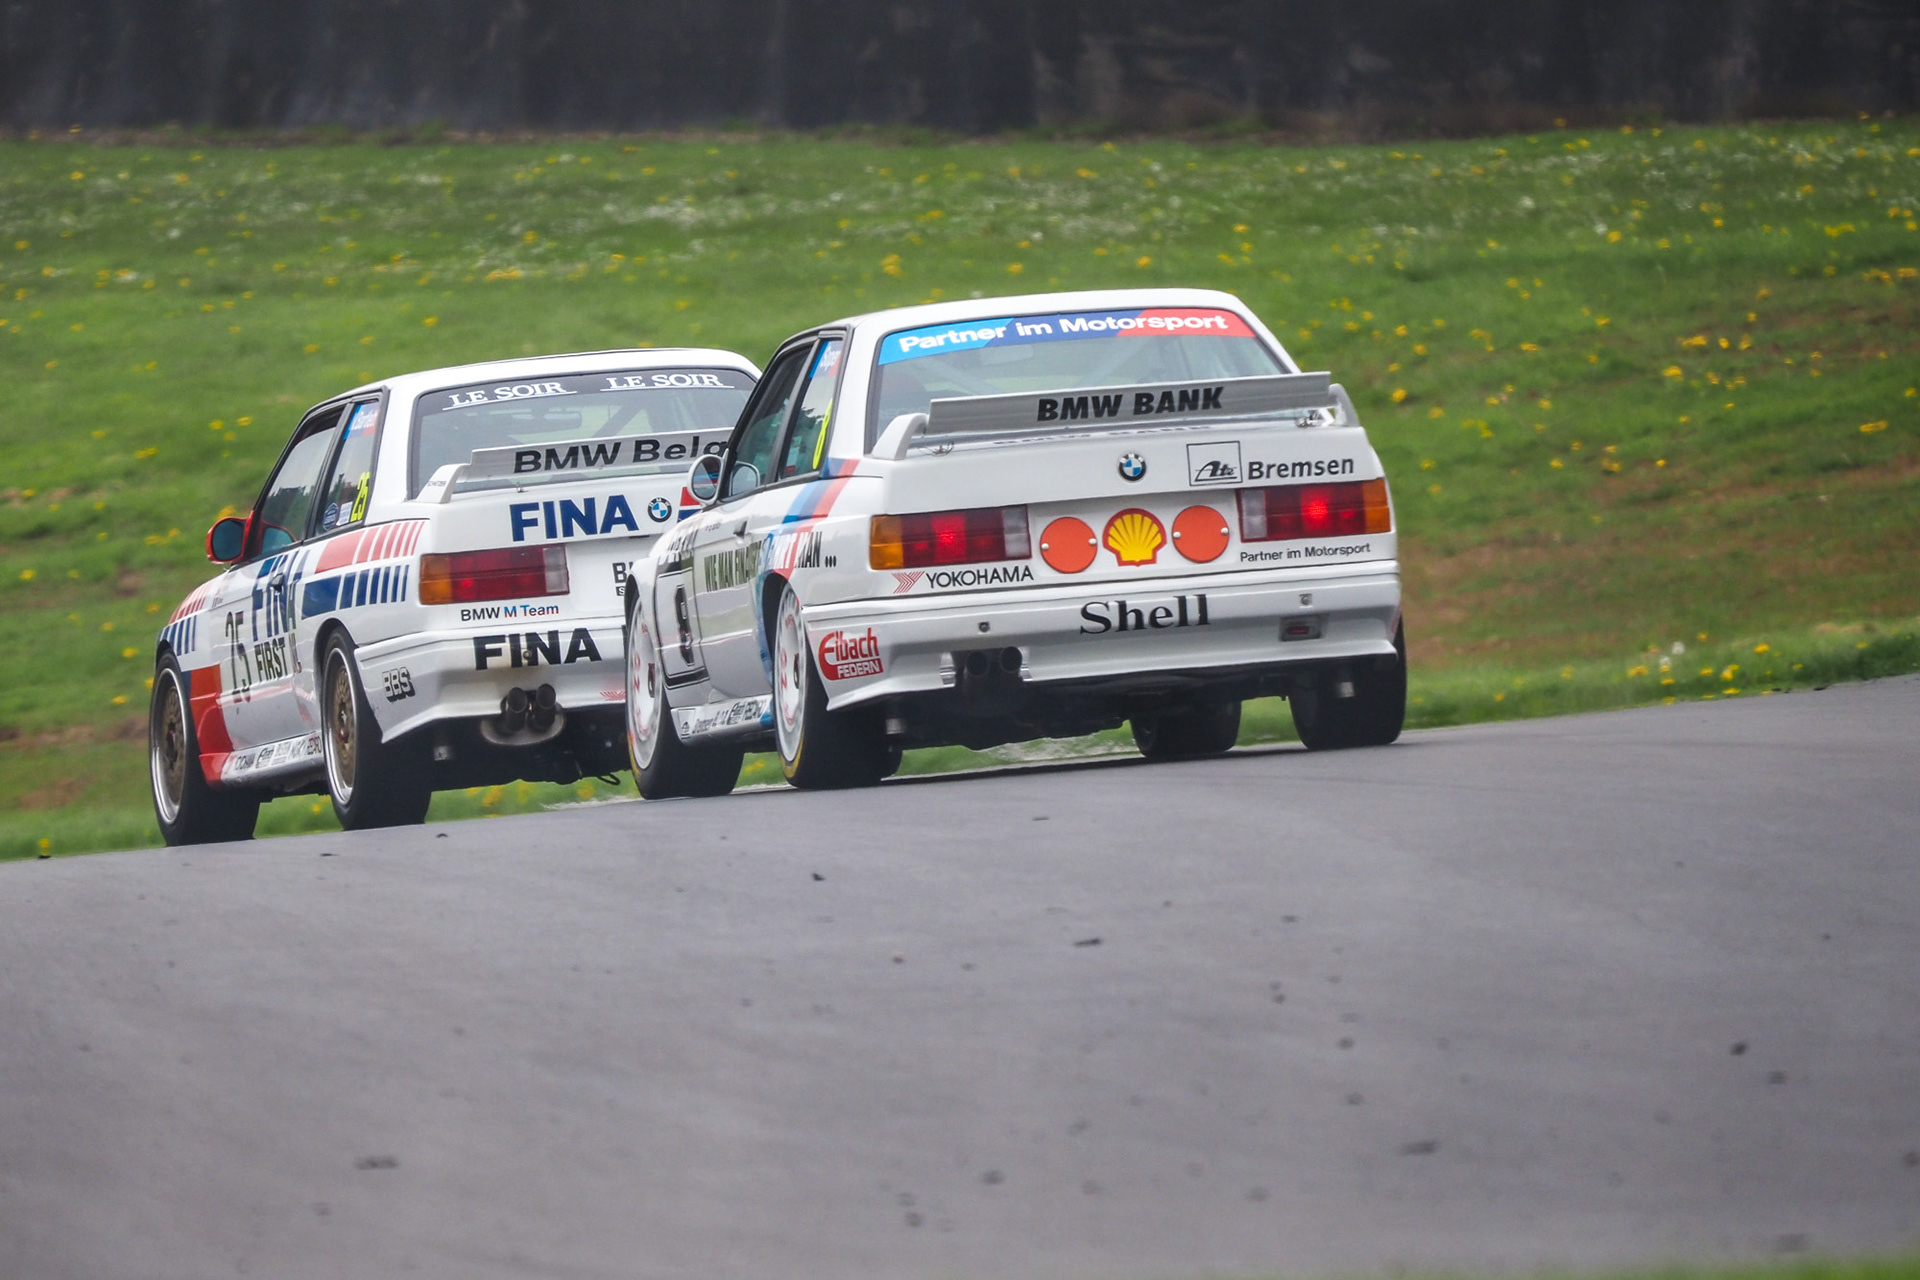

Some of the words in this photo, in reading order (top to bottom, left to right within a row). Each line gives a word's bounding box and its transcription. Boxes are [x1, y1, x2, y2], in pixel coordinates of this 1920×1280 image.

[899, 325, 1006, 352] Partner
[1015, 322, 1052, 337] im
[1059, 315, 1228, 333] Motorsport
[449, 392, 488, 407] LE
[493, 382, 567, 400] SOIR
[605, 375, 648, 389] LE
[651, 374, 724, 387] SOIR
[1037, 394, 1122, 421] BMW
[1133, 387, 1224, 416] BANK
[513, 441, 621, 474] BMW
[1248, 458, 1354, 480] Bremsen
[350, 471, 370, 522] 25
[510, 494, 639, 542] FINA
[1240, 549, 1283, 563] Partner
[1287, 548, 1301, 559] im
[1304, 542, 1371, 558] Motorsport
[926, 565, 1034, 589] YOKOHAMA
[461, 608, 500, 622] BMW
[504, 606, 517, 618] M
[520, 604, 559, 617] Team
[1080, 594, 1211, 634] Shell
[253, 637, 288, 683] FIRST
[473, 628, 602, 670] FINA
[818, 627, 880, 680] Eibach
[382, 667, 415, 702] BBS
[837, 662, 880, 678] FEDERN
